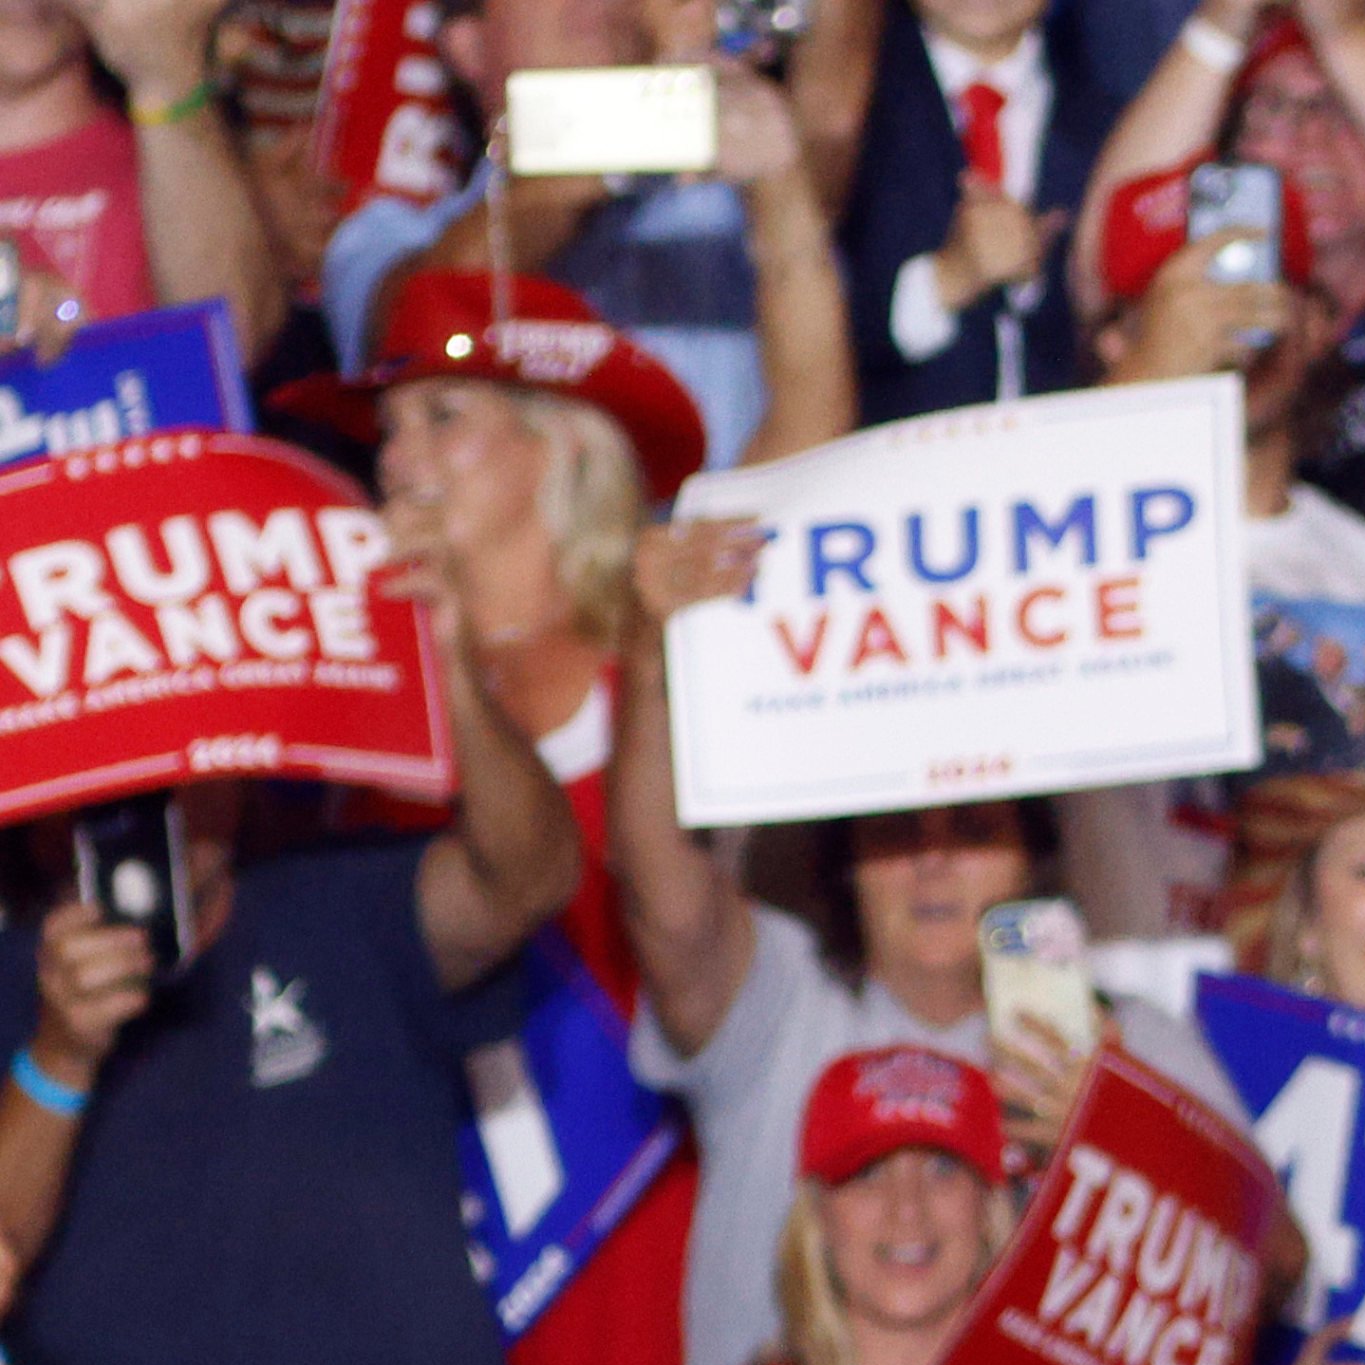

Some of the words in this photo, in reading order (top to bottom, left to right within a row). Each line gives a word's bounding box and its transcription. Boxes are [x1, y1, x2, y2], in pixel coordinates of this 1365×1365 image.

[2, 506, 392, 630] RUMP
[772, 570, 1147, 678] VANCE
[0, 588, 378, 698] VANCE
[1052, 1144, 1262, 1338] TRUMP
